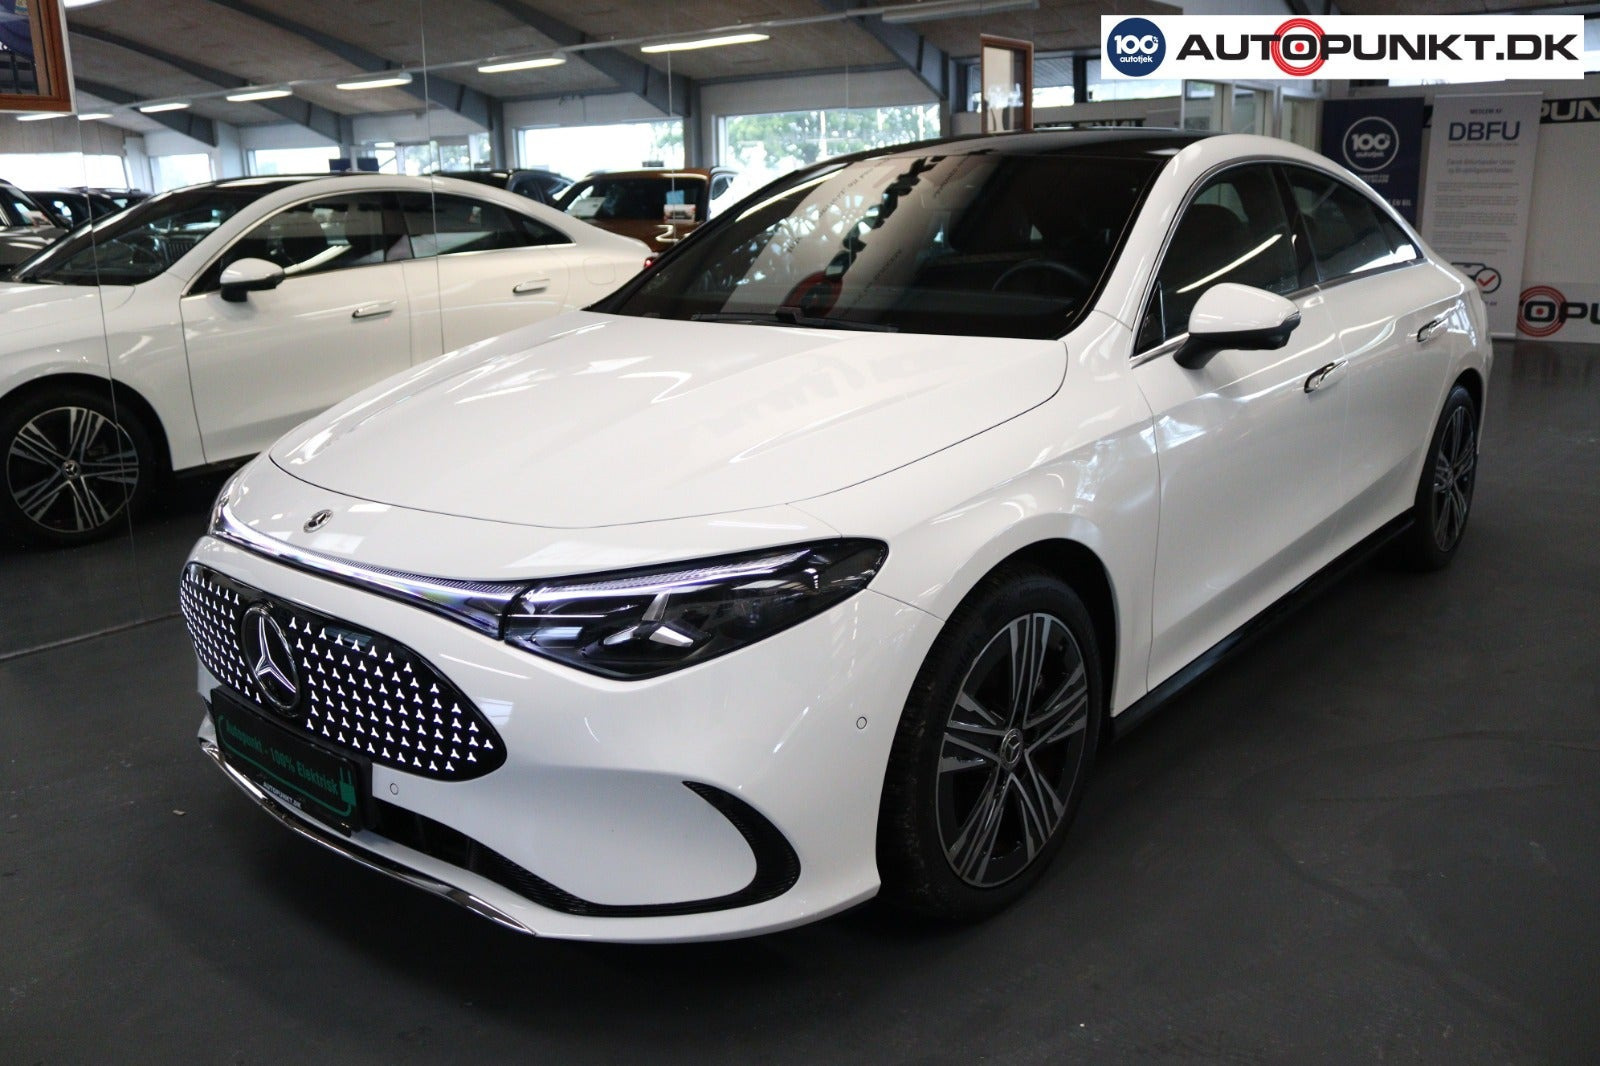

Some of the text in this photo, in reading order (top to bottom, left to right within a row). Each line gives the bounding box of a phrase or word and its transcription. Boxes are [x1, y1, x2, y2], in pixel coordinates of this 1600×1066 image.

[1448, 121, 1520, 141] DBFU
[270, 747, 296, 774] 100%
[296, 760, 339, 796] Elektrisk
